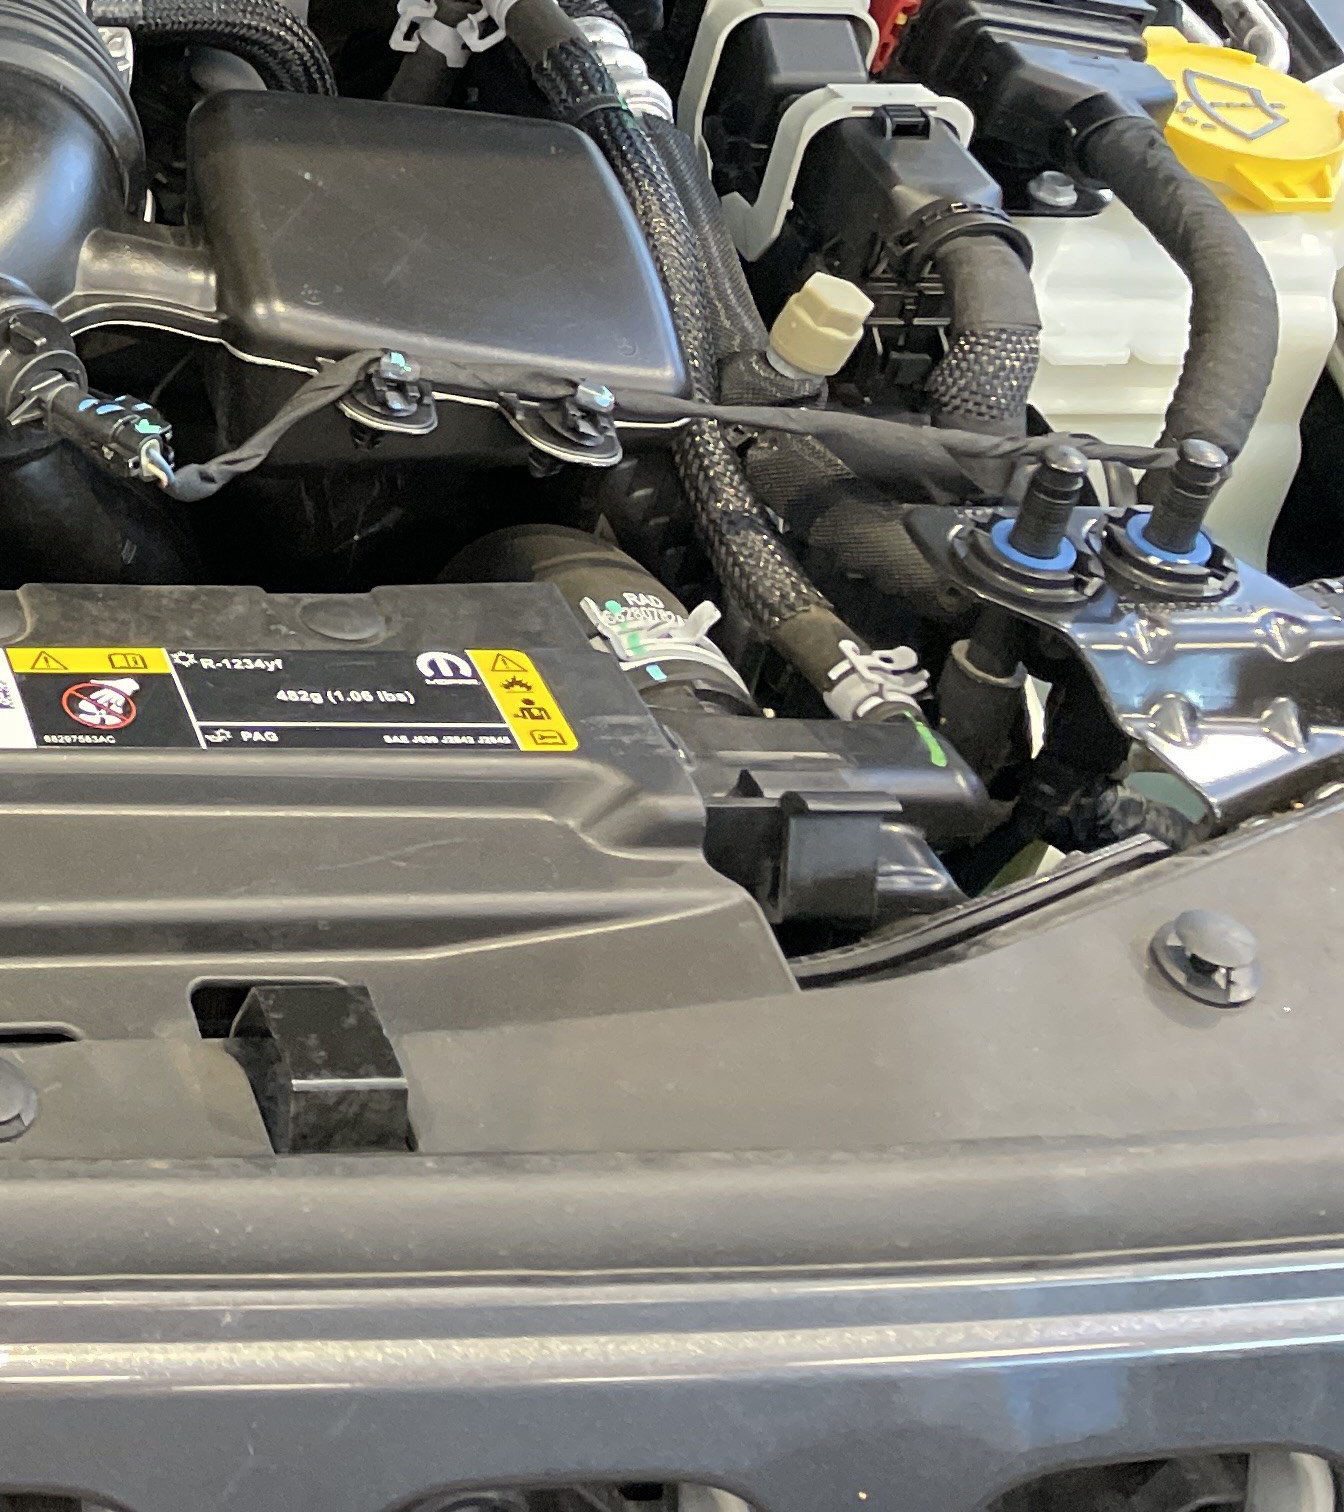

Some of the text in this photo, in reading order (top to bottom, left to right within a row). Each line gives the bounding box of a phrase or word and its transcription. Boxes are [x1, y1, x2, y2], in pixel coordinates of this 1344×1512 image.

[622, 592, 665, 608] RAD
[199, 658, 283, 672] R-1234yf
[240, 730, 279, 742] PAG
